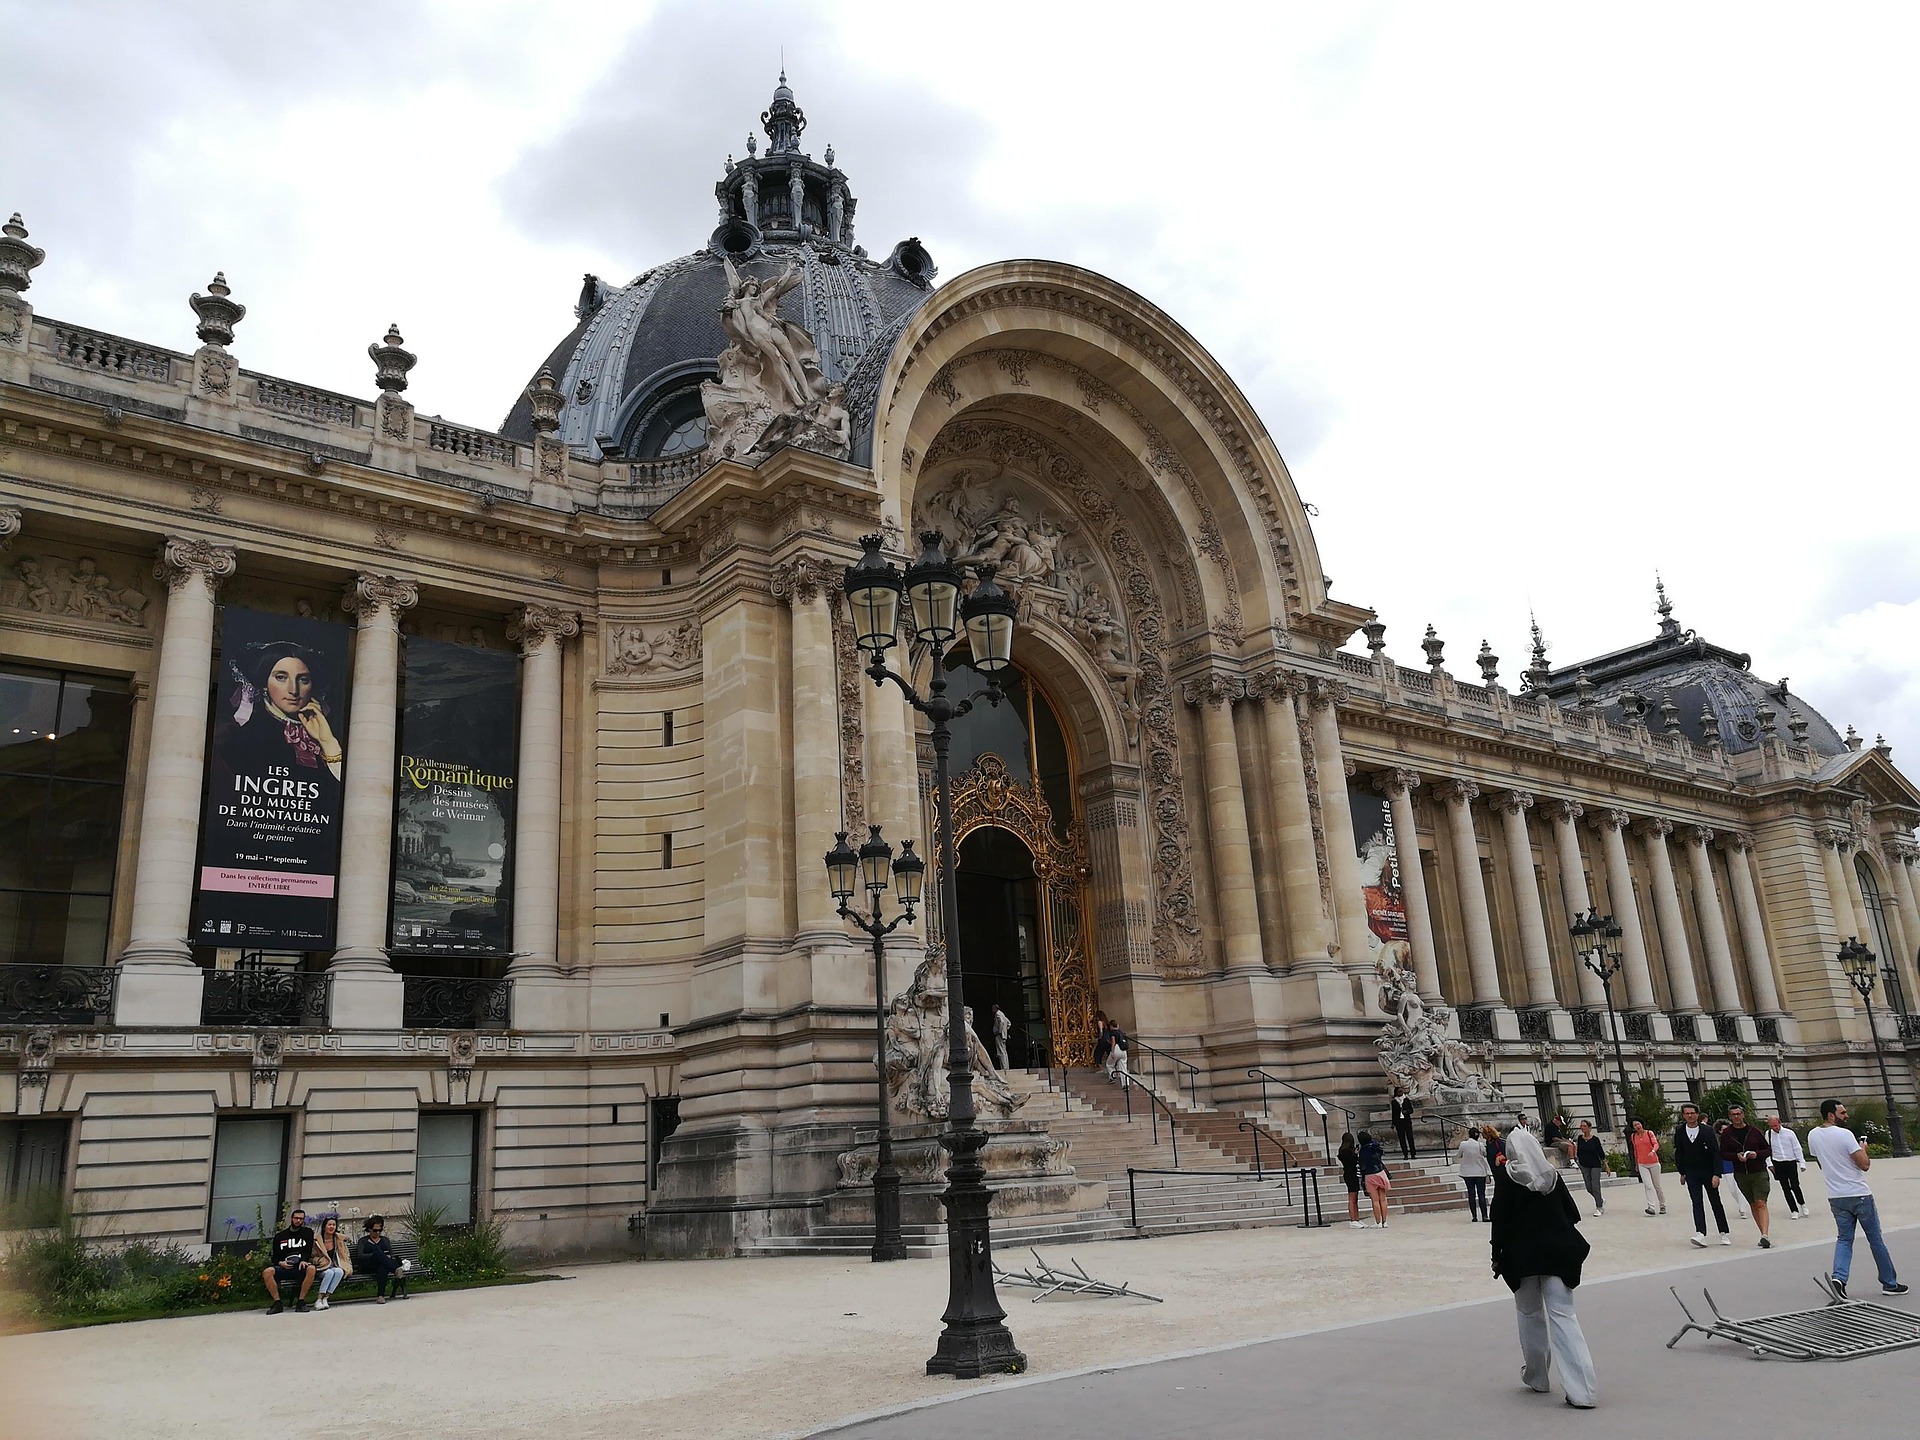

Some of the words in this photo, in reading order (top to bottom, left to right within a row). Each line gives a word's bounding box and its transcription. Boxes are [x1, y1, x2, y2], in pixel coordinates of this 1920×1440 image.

[268, 766, 289, 776] LES
[416, 758, 468, 771] L'Allemagne
[400, 755, 514, 791] Romantique
[234, 774, 319, 799] INGRES
[434, 785, 472, 798] Dessins
[241, 795, 261, 805] DU
[267, 798, 312, 810] MUSÉE
[432, 796, 450, 807] des
[452, 800, 489, 810] musées
[219, 805, 237, 815] DE
[242, 807, 330, 824] MONTAUBAN
[432, 808, 444, 818] de
[446, 809, 486, 821] Weimar
[226, 819, 247, 828] Dans
[250, 821, 285, 831] l'intimité
[287, 824, 321, 834] créatrice
[1382, 800, 1395, 847] Palais
[266, 833, 294, 842] peintre
[273, 856, 308, 865] septembre
[1388, 850, 1401, 889] Petit
[248, 874, 280, 882] collections
